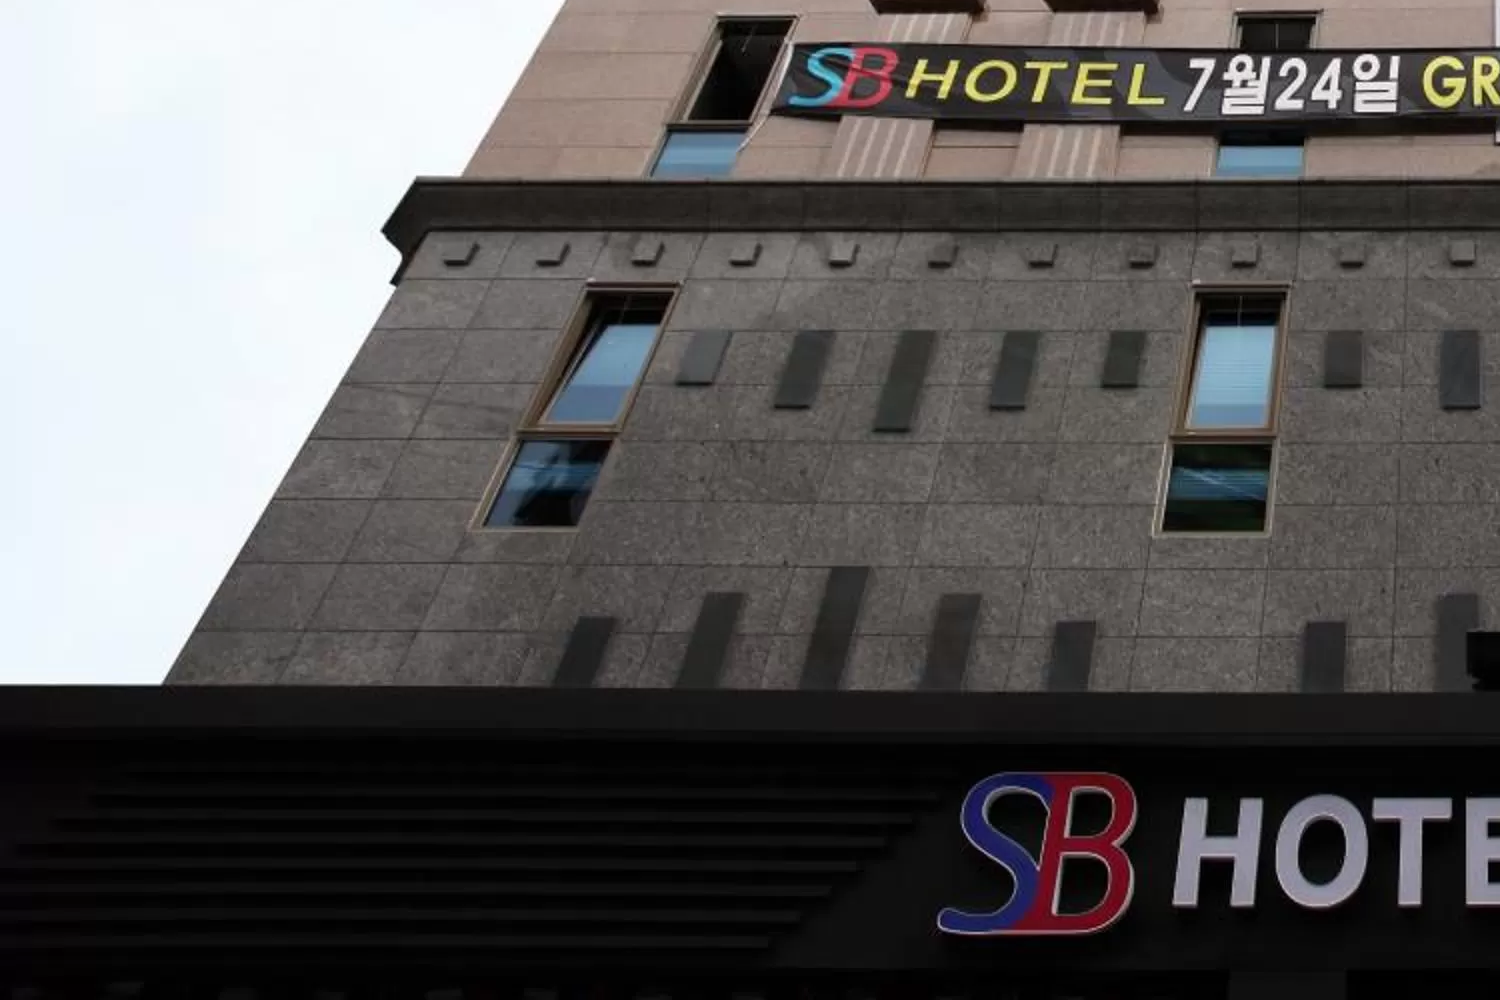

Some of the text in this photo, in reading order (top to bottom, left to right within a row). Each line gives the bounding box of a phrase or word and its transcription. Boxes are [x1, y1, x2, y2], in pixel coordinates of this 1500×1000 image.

[788, 46, 899, 108] SB
[904, 58, 1166, 106] HOTEL
[1182, 53, 1399, 115] 7월24일
[937, 771, 1138, 935] SB
